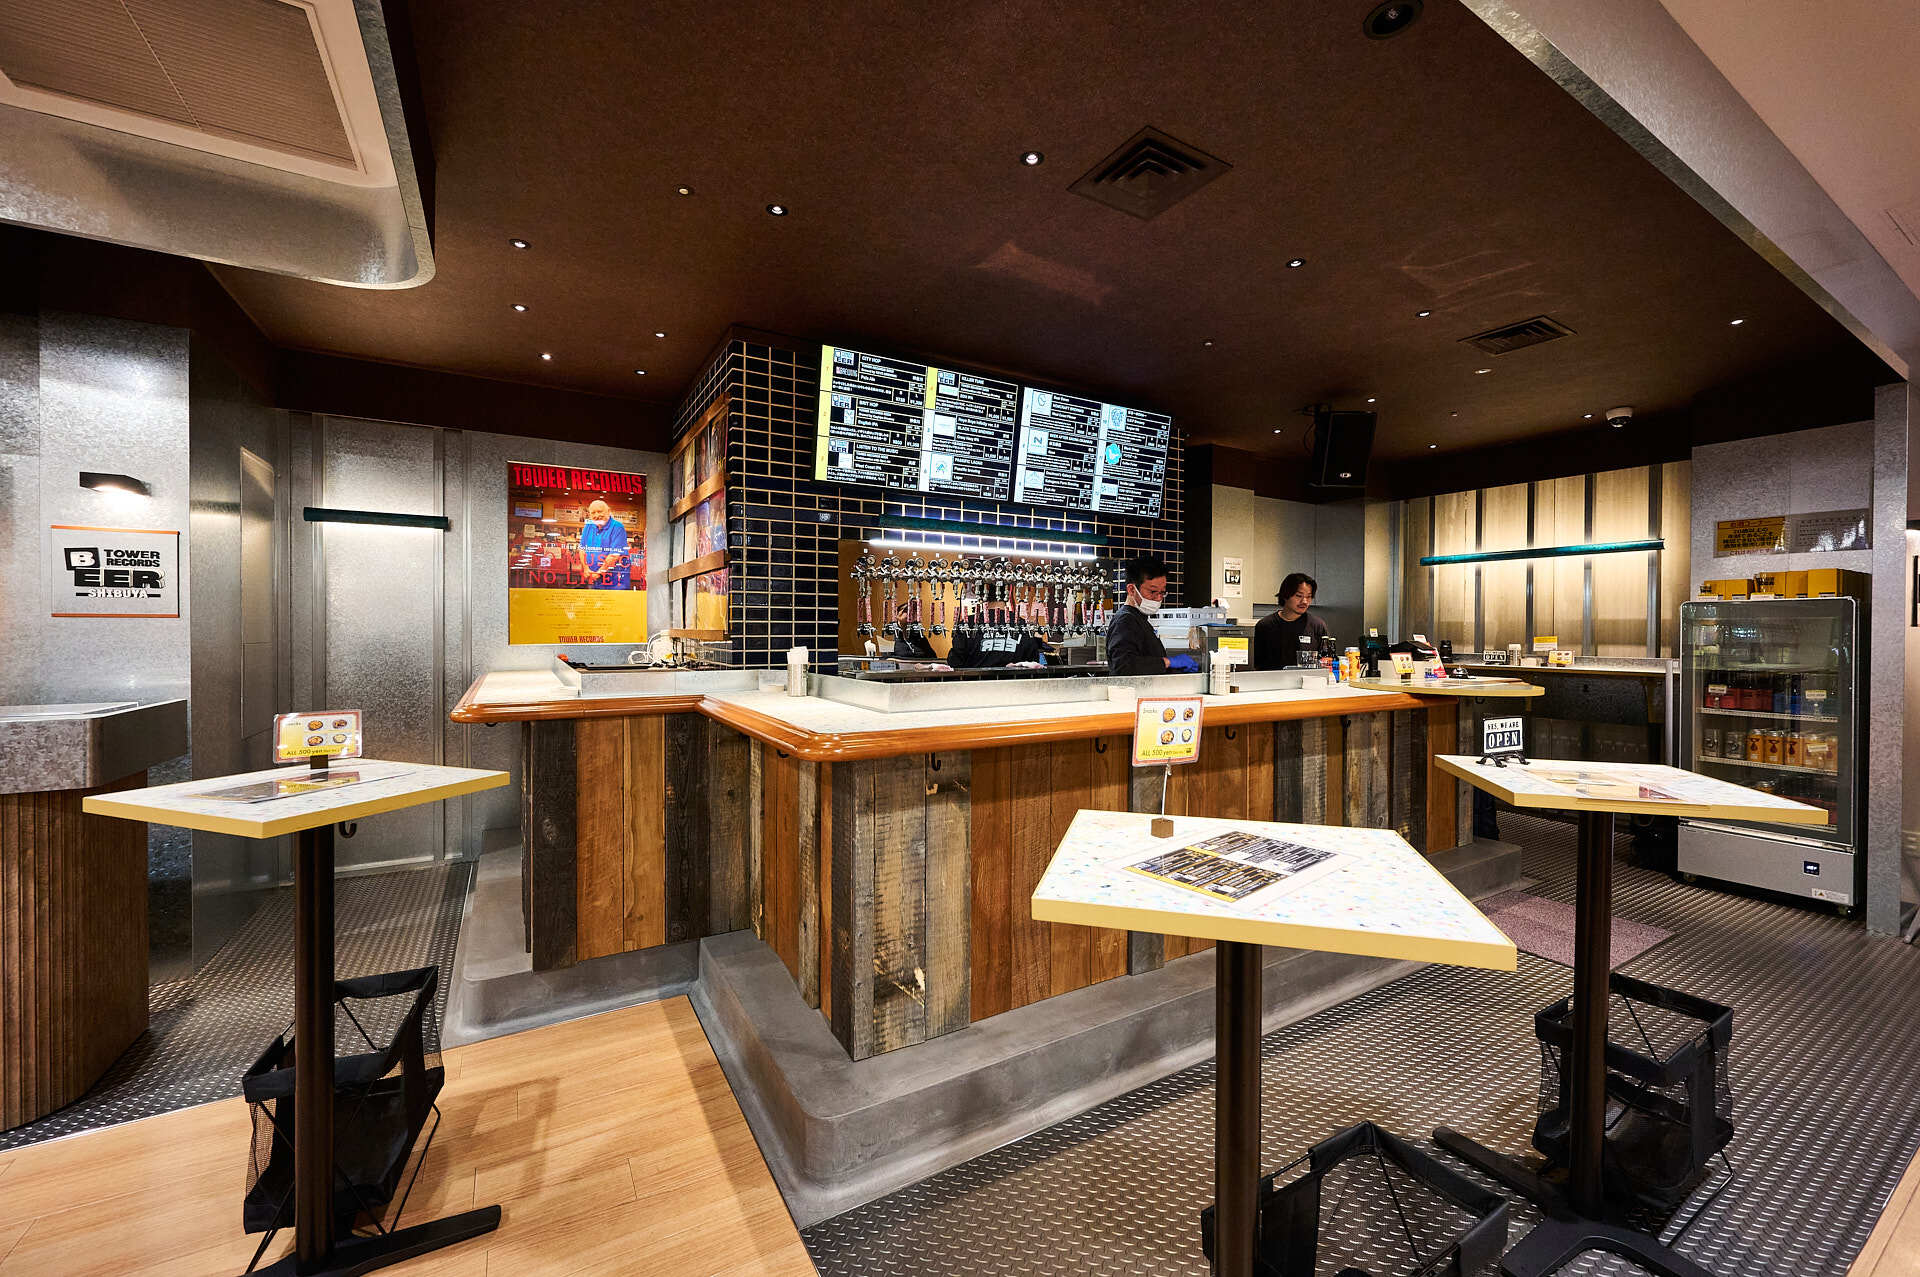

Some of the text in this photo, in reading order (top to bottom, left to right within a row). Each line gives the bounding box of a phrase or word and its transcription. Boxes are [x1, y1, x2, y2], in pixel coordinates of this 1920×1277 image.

[514, 466, 642, 494] TOWER RECORDS
[104, 549, 160, 559] TOWER
[106, 558, 160, 567] RECORDS
[528, 571, 623, 586] NO LIFE!
[88, 589, 148, 599] SHIBUYA
[1488, 731, 1518, 748] OPEN
